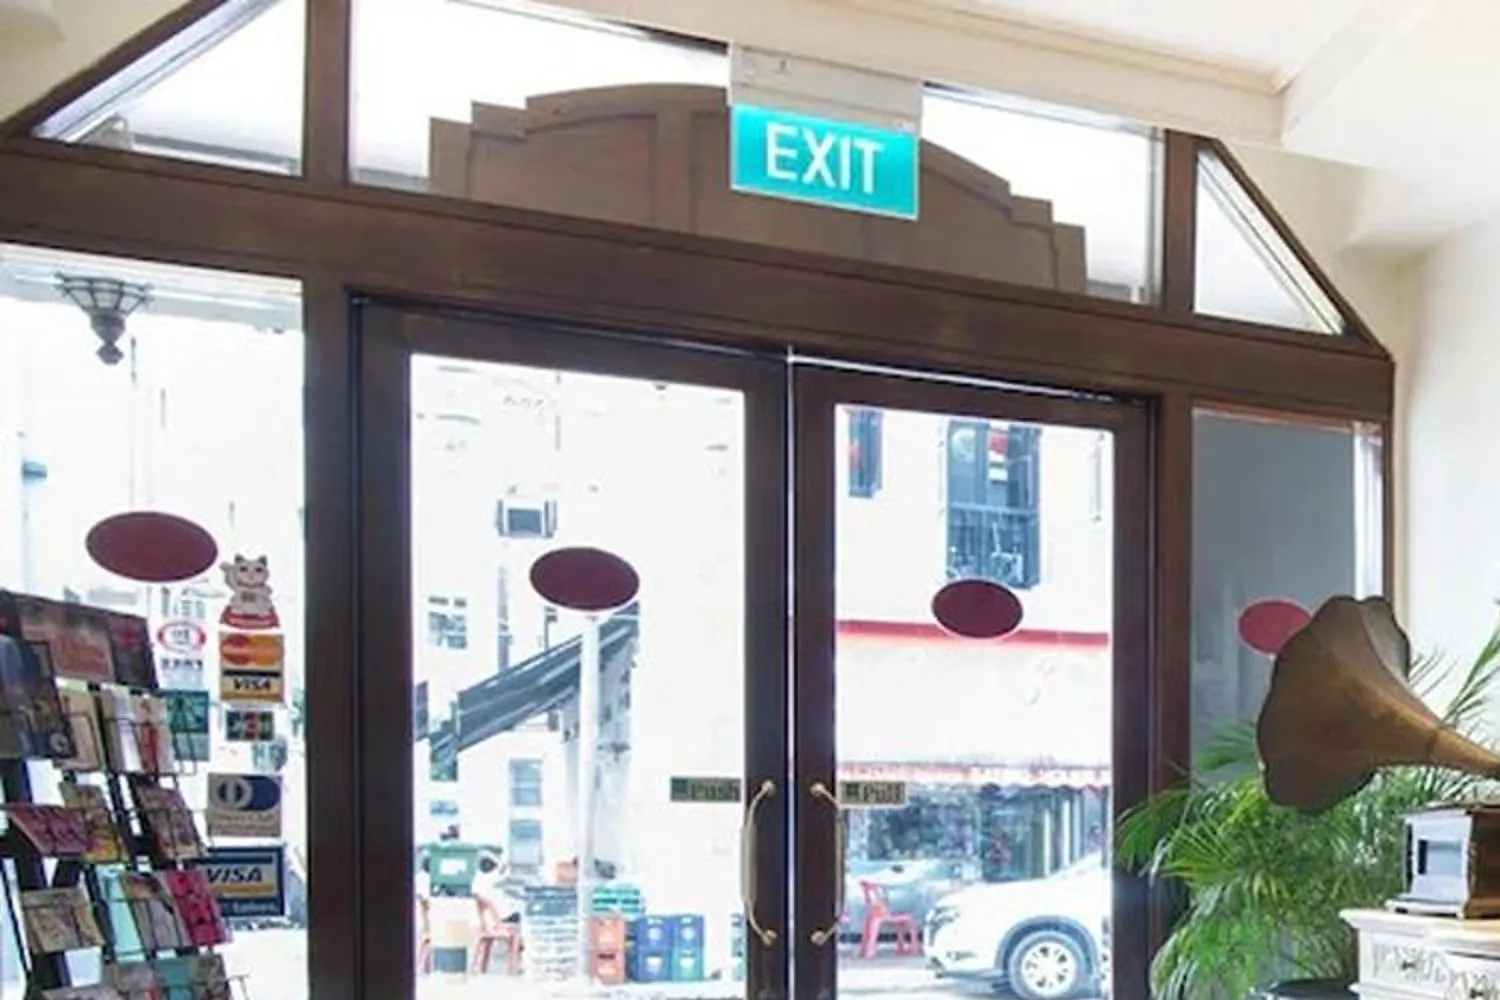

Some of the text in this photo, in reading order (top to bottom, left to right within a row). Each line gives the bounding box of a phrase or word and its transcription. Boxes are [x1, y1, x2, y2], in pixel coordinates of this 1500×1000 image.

[766, 122, 884, 193] EXIT
[233, 677, 272, 691] VISA
[206, 866, 264, 884] VISA
